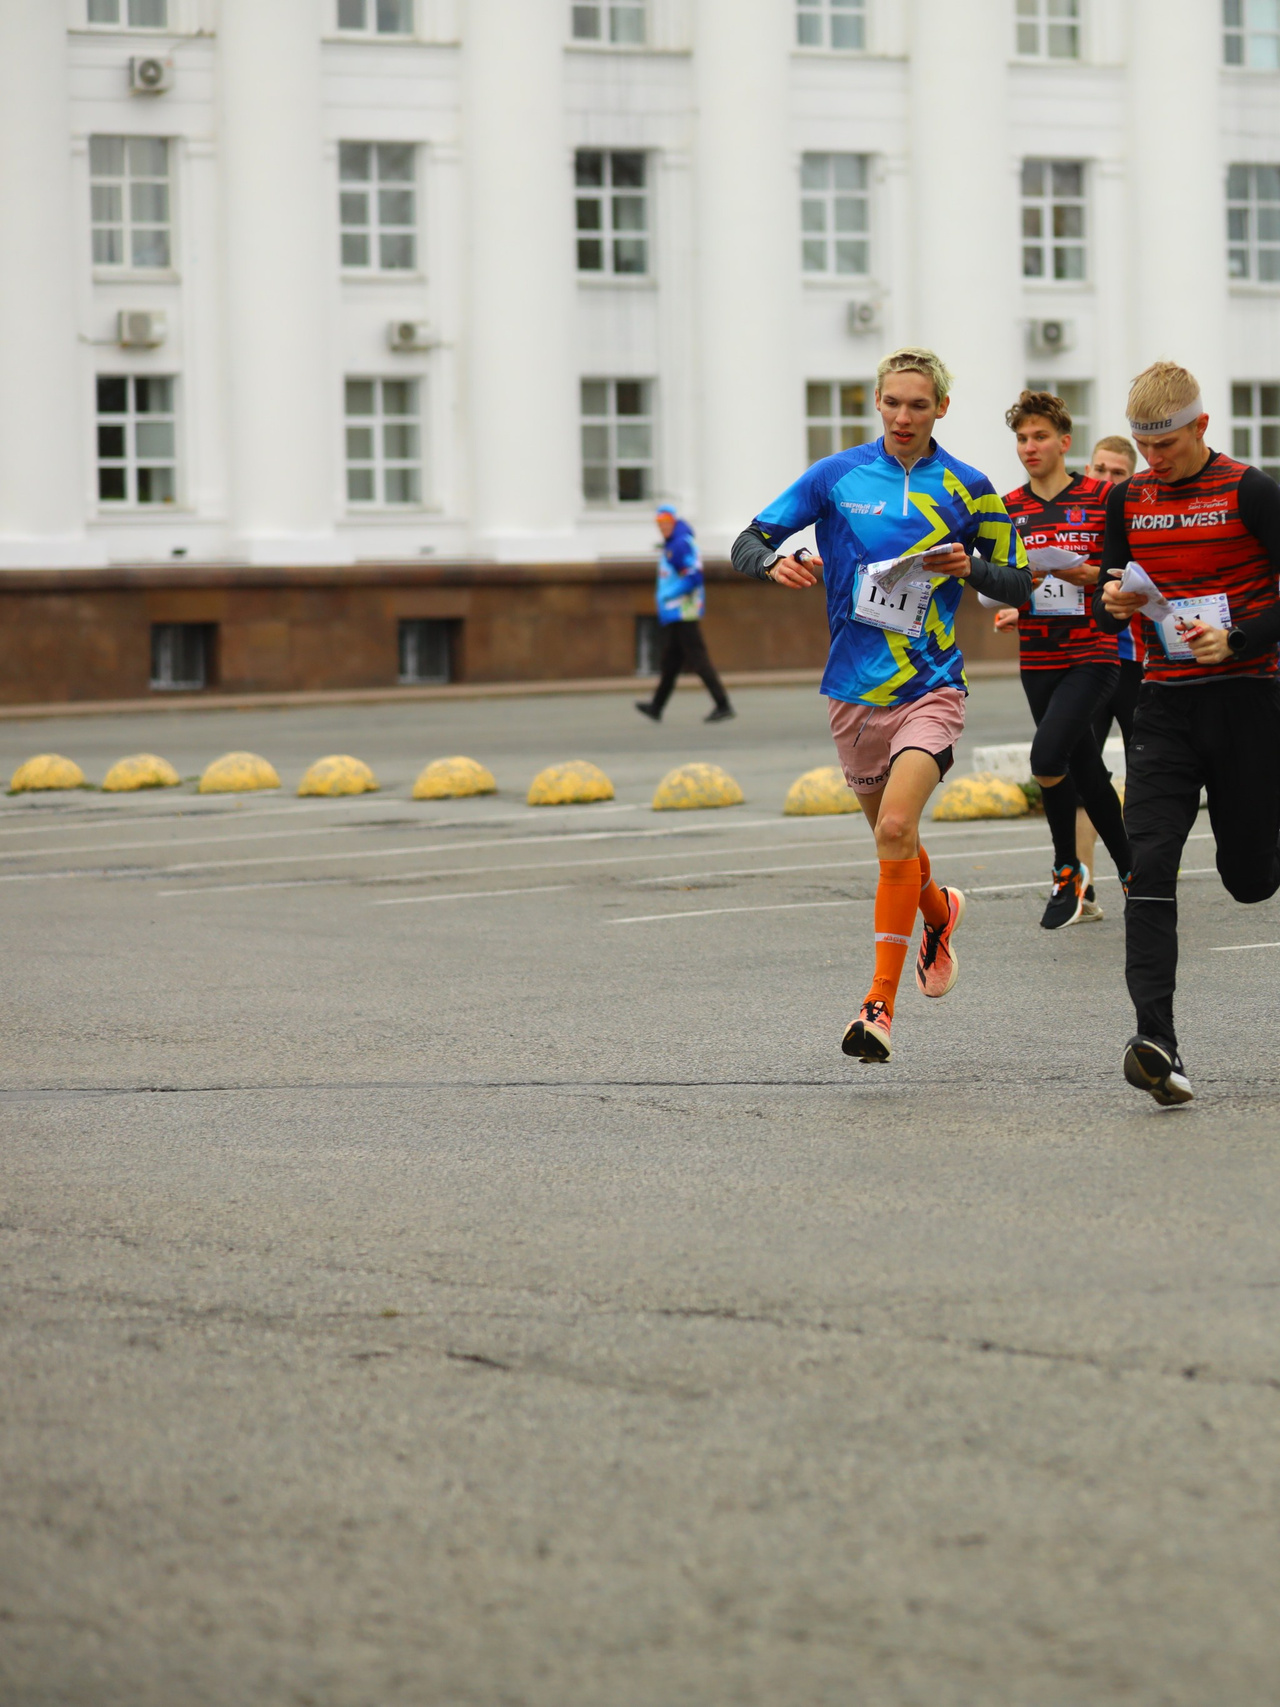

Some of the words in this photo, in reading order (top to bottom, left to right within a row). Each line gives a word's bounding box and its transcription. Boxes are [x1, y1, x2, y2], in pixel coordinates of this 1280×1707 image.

[1131, 418, 1173, 431] oname
[1131, 513, 1175, 530] NORD
[1180, 509, 1229, 528] WEST
[1023, 534, 1048, 546] RD
[1054, 532, 1100, 543] WEST
[1043, 584, 1065, 598] 5.1
